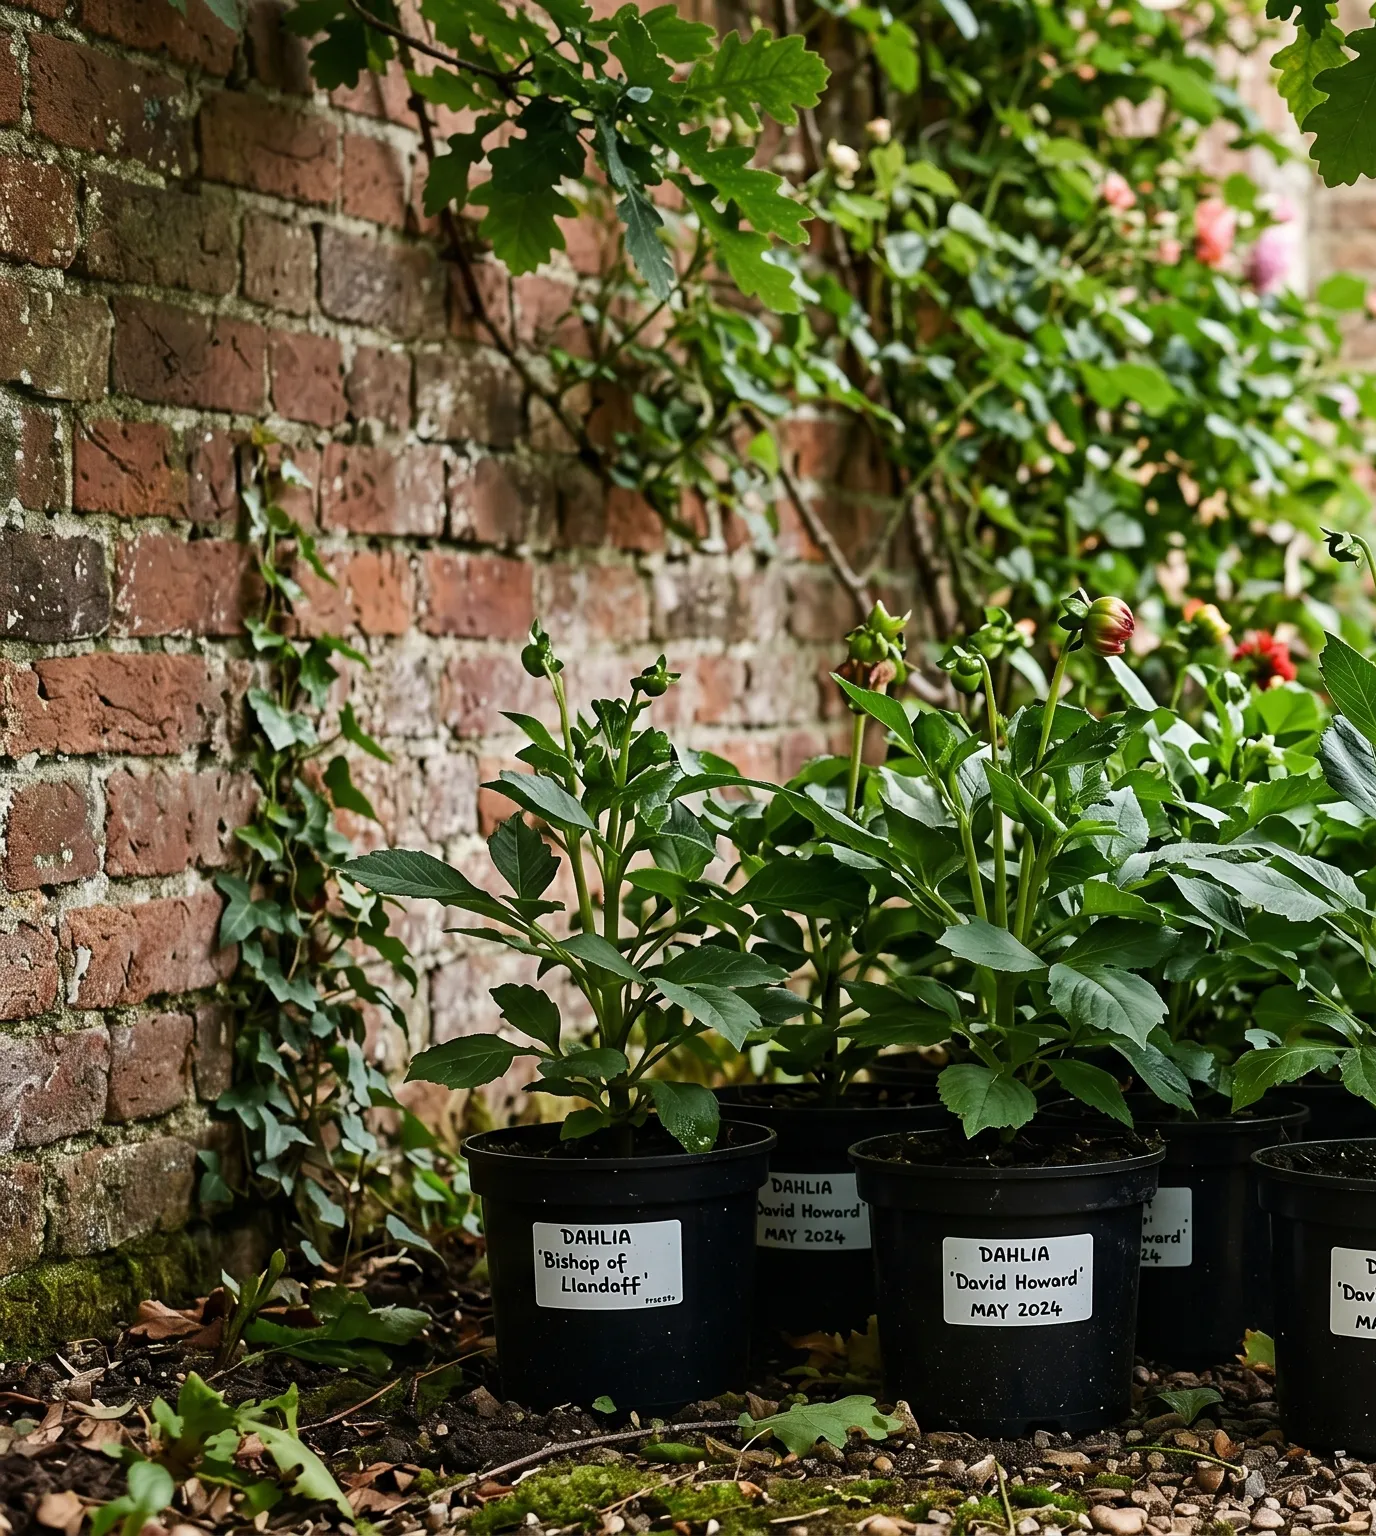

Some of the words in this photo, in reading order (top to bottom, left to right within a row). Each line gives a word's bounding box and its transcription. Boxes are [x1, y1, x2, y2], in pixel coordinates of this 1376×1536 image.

[770, 1178, 832, 1194] DAHLIA
[801, 1202, 866, 1218] Howard'
[560, 1228, 632, 1245] DAHLIA
[764, 1227, 797, 1243] MAY
[804, 1229, 846, 1245] 2024
[1142, 1228, 1186, 1244] ward'
[538, 1249, 600, 1275] 'Bishop
[606, 1253, 627, 1273] of
[978, 1246, 1050, 1263] DAHLIA
[1141, 1248, 1162, 1264] 24
[561, 1272, 648, 1295] Llandaff'
[950, 1270, 1006, 1290] 'David
[1015, 1266, 1083, 1290] Howard'
[970, 1303, 1009, 1320] MAY
[1017, 1300, 1063, 1317] 2024
